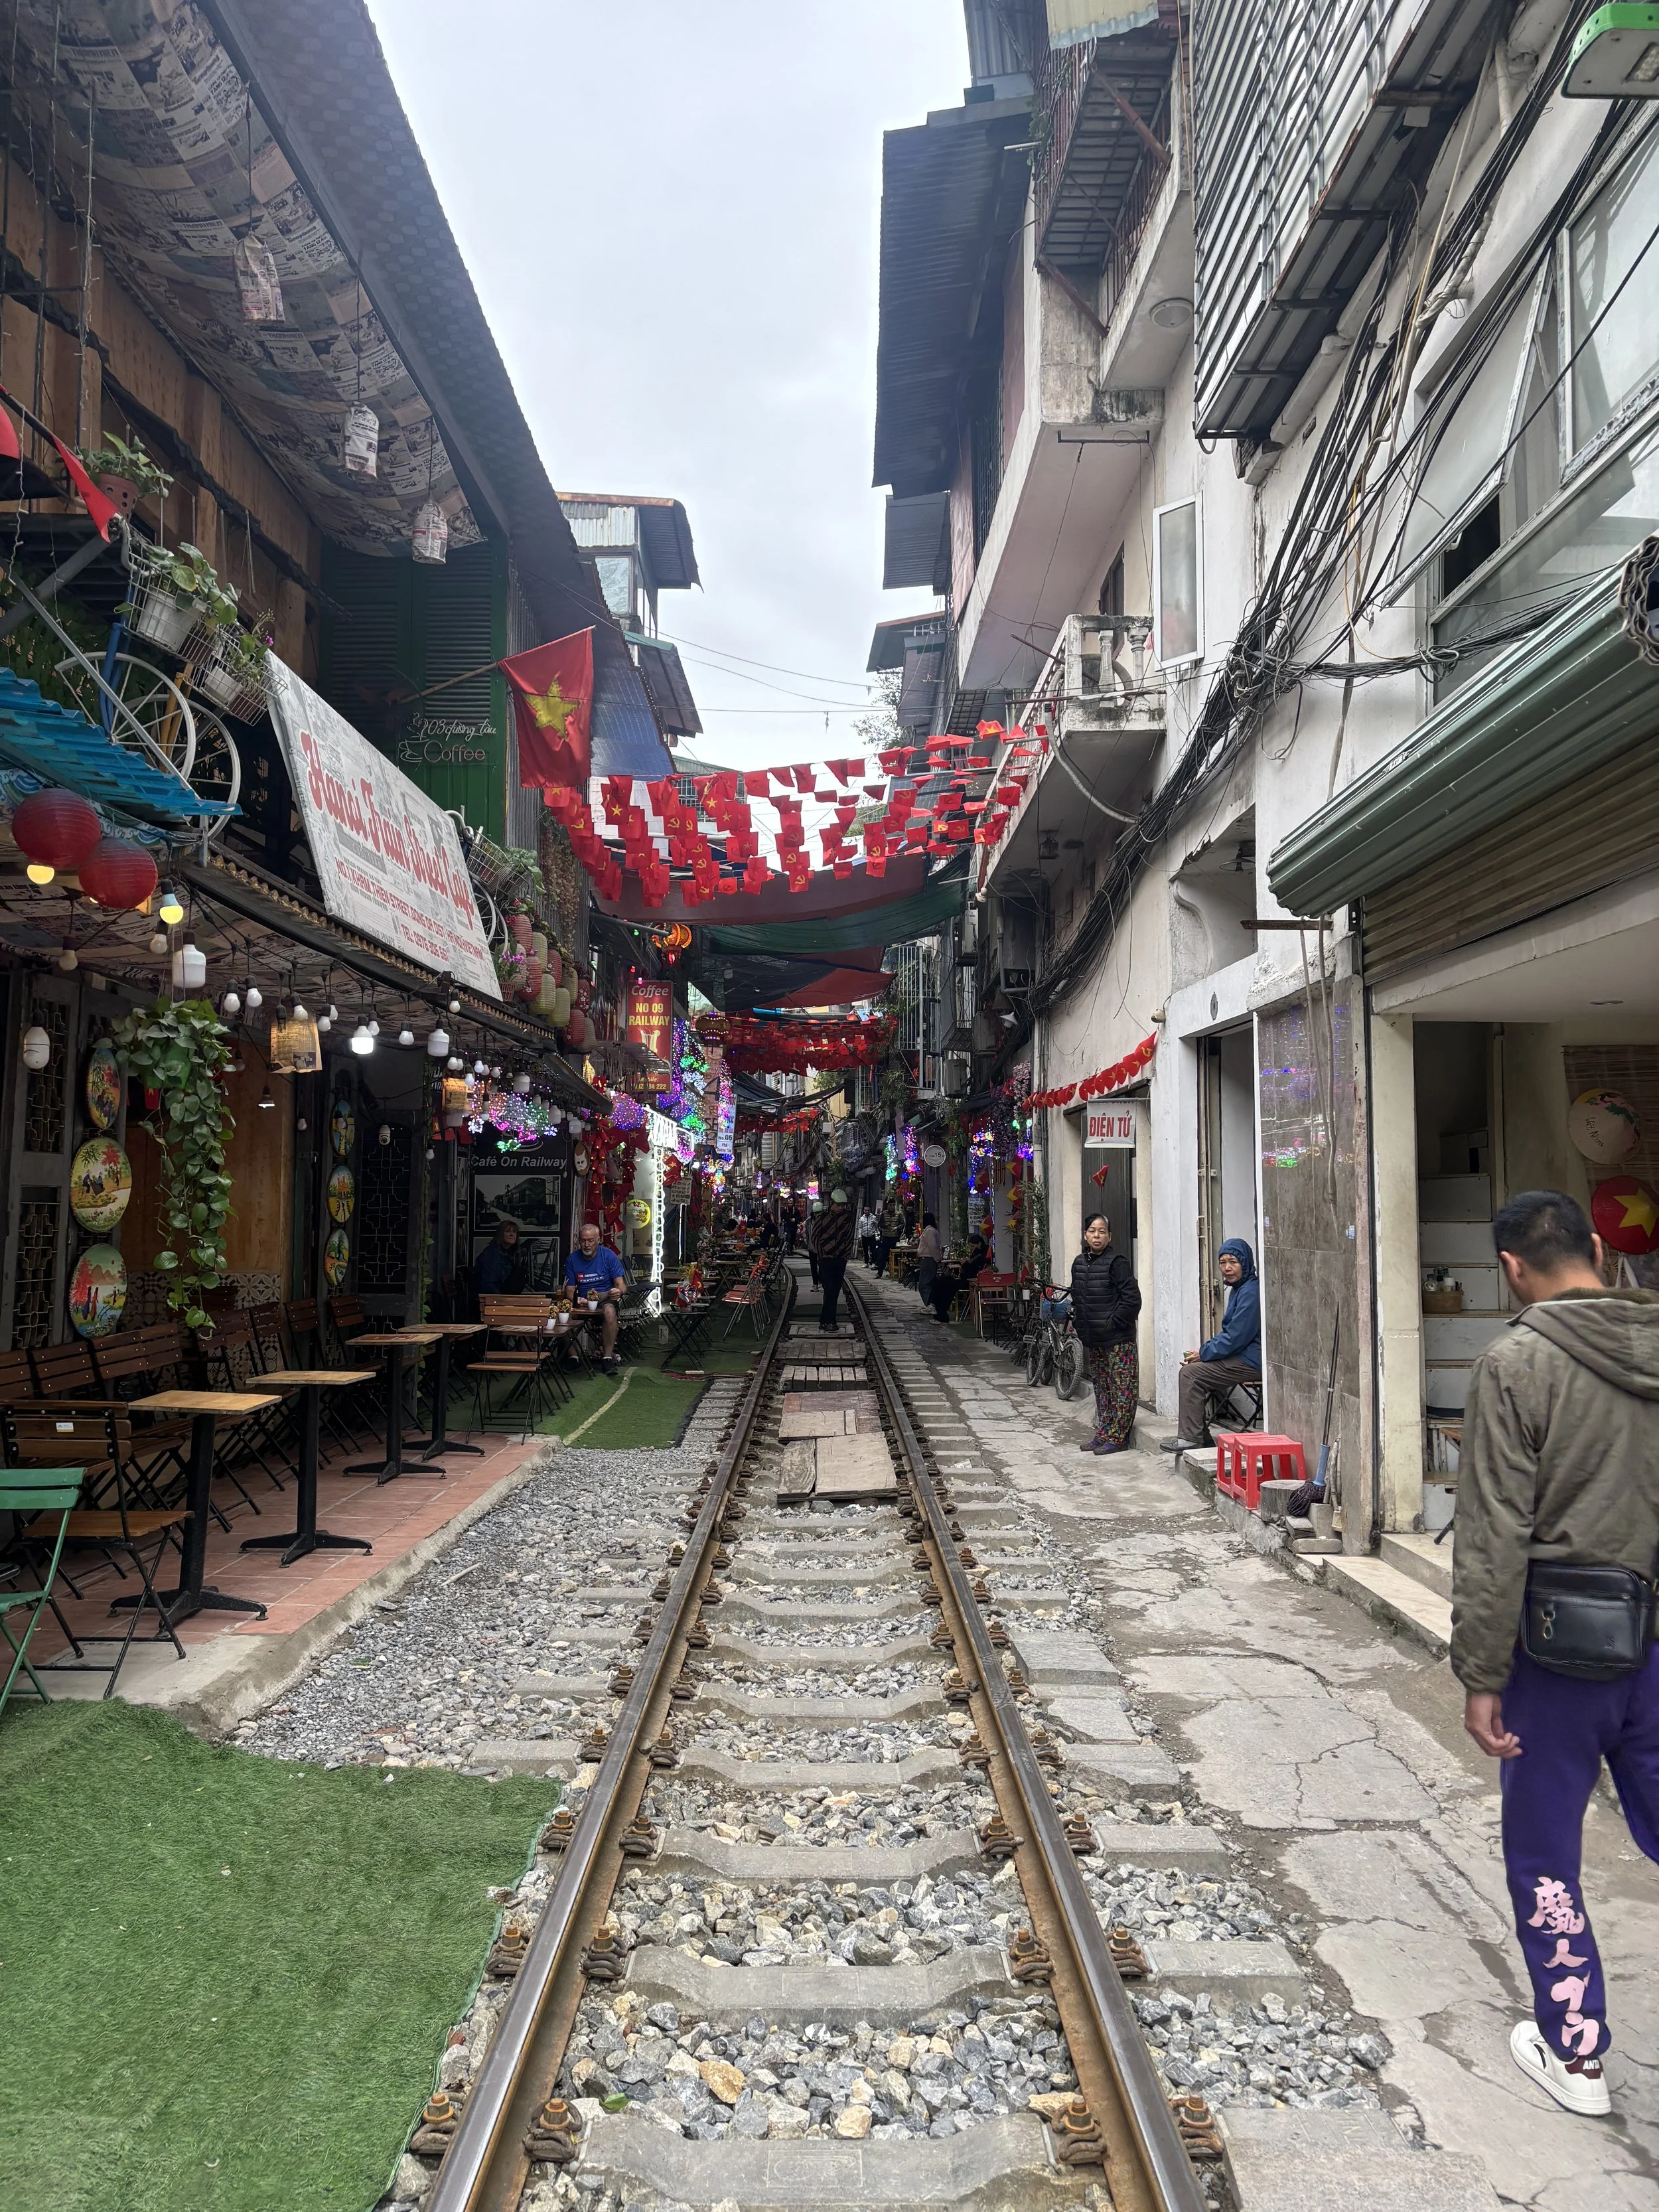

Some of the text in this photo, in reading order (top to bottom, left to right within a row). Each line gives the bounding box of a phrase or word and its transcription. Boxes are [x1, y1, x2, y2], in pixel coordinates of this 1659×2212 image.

[424, 740, 486, 763] Coffee
[300, 731, 368, 842] Hanoi
[360, 777, 411, 873] Train
[403, 814, 449, 899] Street
[631, 985, 669, 998] Coffee
[635, 1003, 664, 1013] NO 09
[628, 1015, 670, 1026] RAILWAY
[1089, 1110, 1132, 1142] ĐIỆN TỬ
[471, 1156, 567, 1169] Café On Railway
